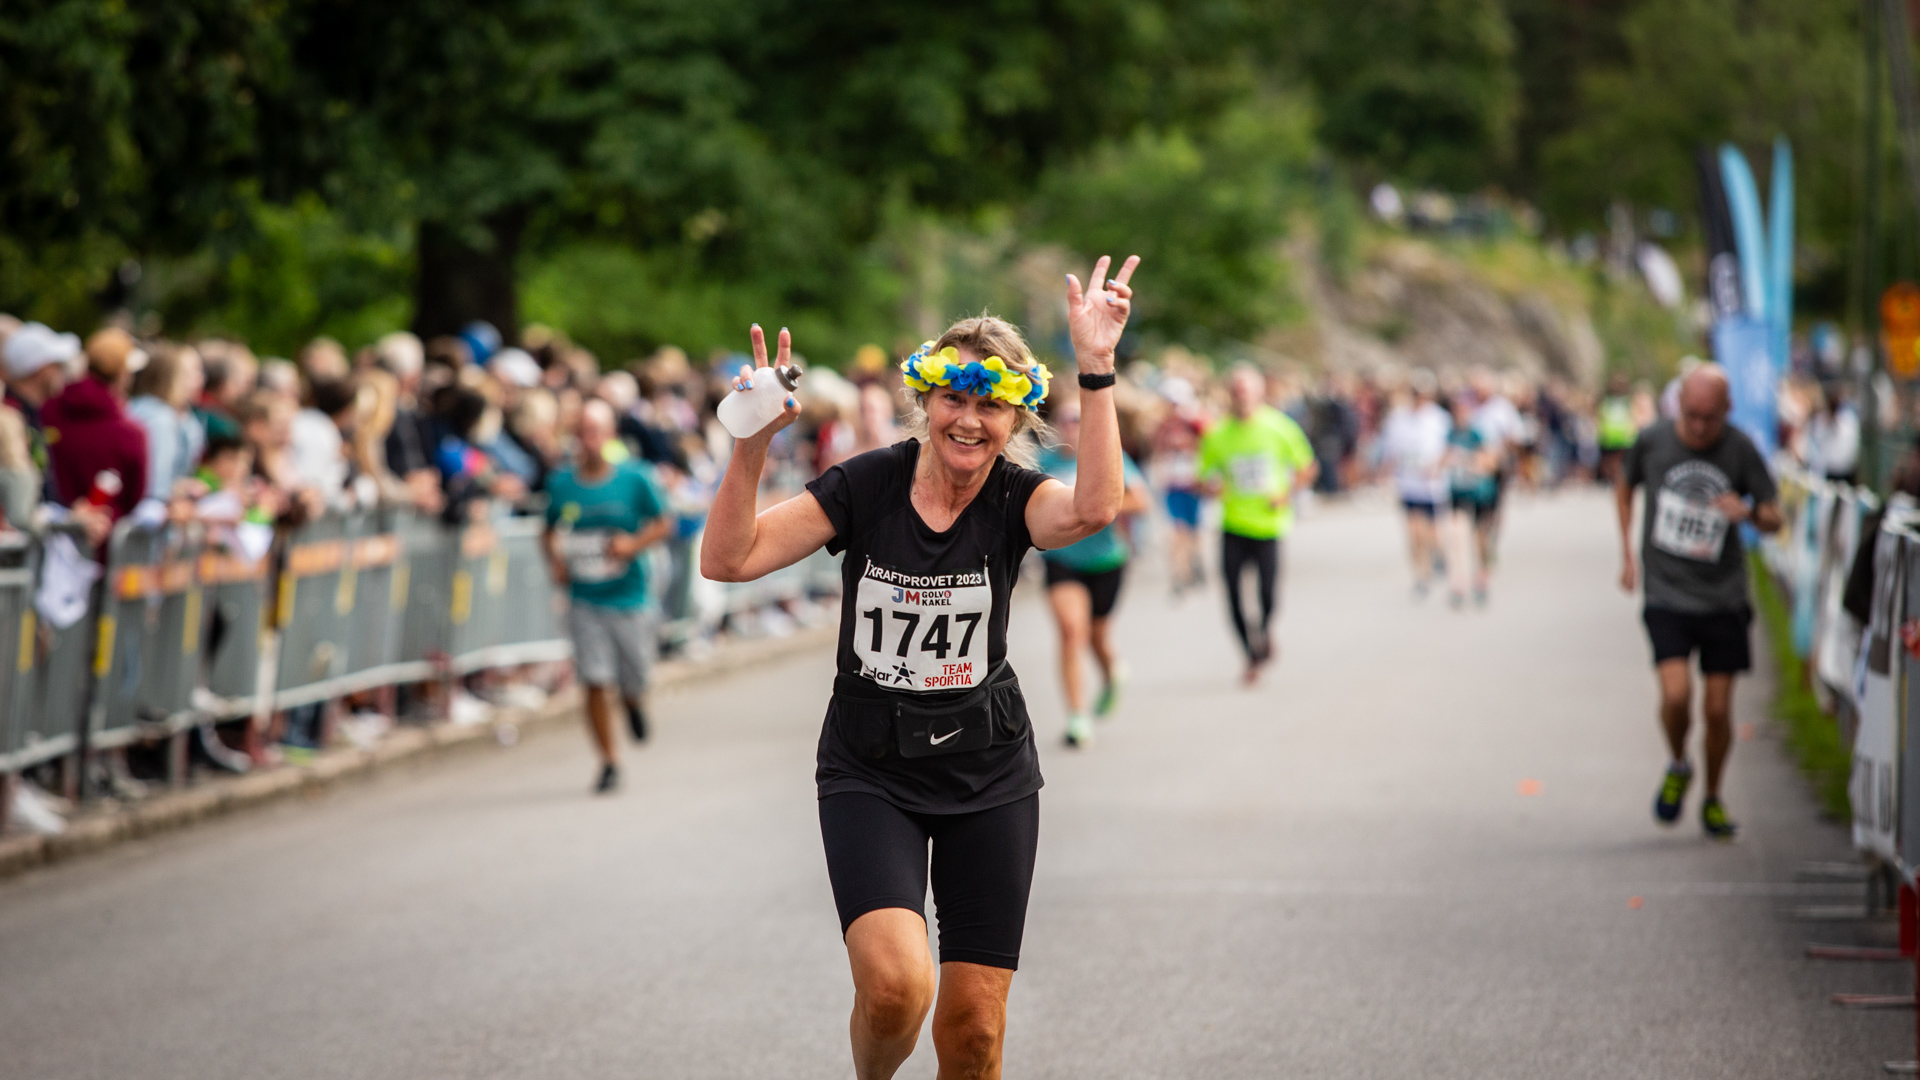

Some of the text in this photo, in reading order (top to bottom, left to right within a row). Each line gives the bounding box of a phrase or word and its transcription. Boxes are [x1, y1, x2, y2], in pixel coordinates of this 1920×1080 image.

[868, 566, 982, 587] KRAFTPROVET 2023
[891, 587, 920, 605] JM
[863, 607, 983, 659] 1747
[942, 662, 972, 675] TEAM
[924, 674, 972, 687] SPORTIA
